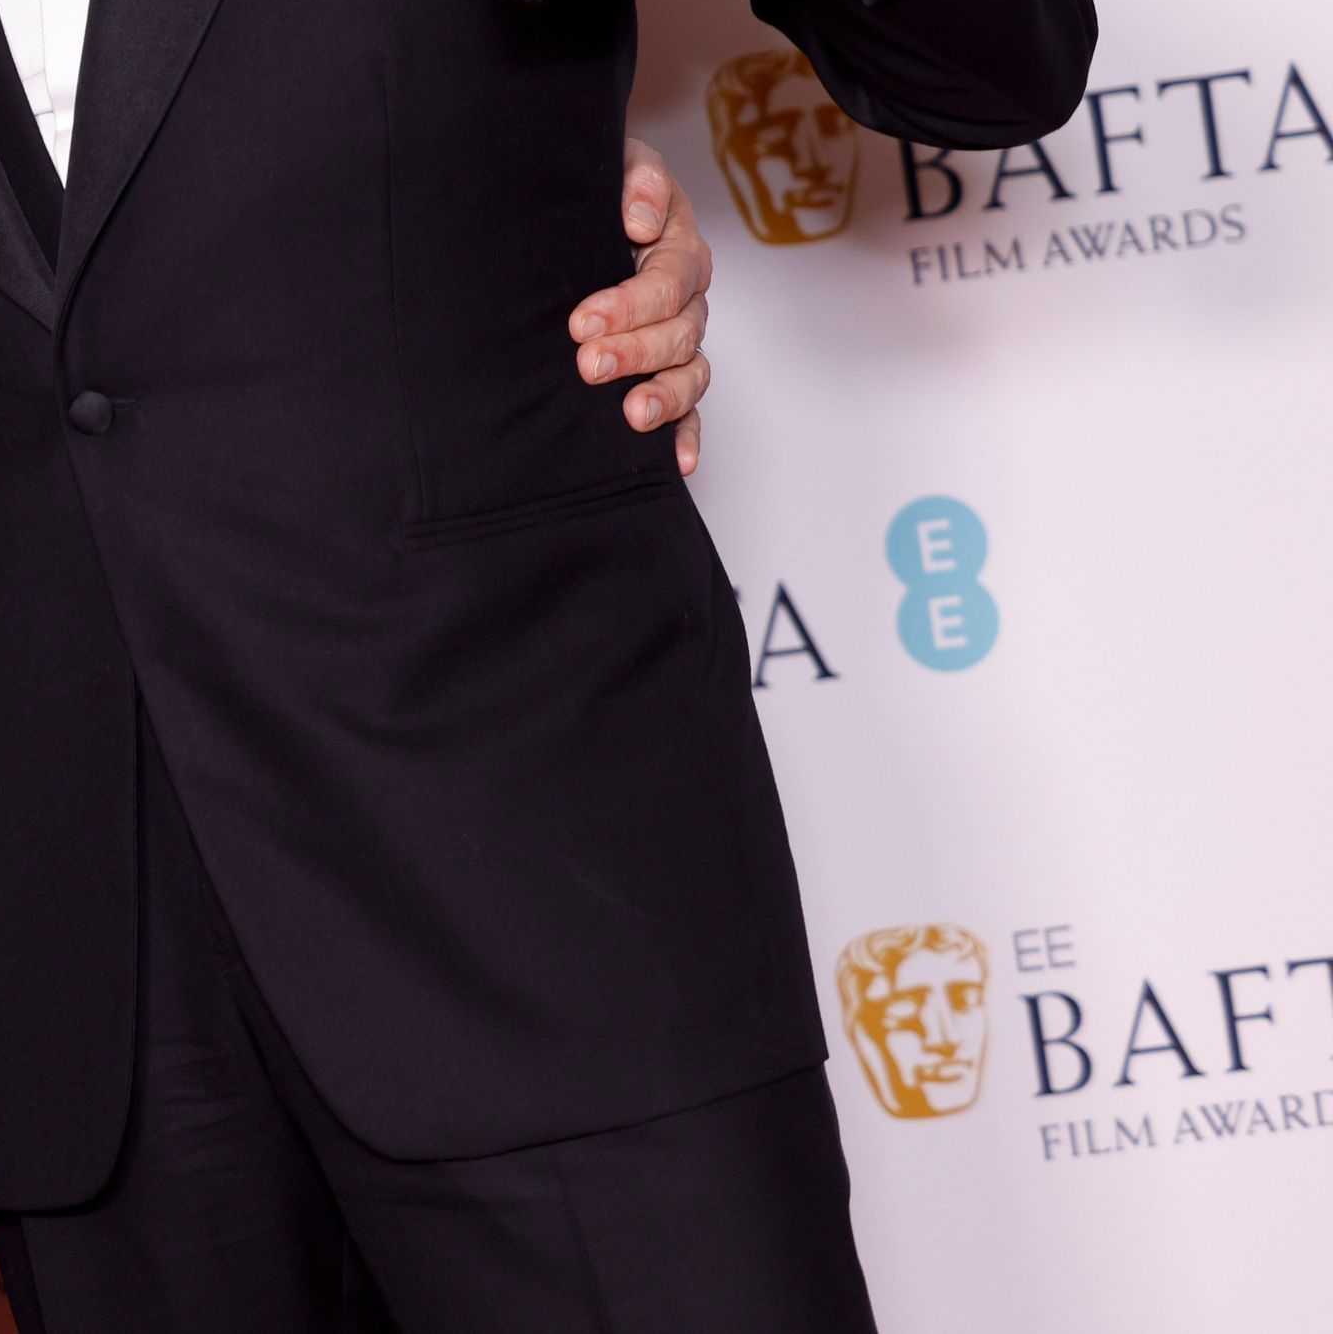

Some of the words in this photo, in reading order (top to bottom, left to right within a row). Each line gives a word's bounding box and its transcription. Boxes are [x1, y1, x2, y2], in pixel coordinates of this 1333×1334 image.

[908, 237, 1026, 287] FILM
[1042, 204, 1247, 270] AWARDS
[1011, 923, 1076, 973] EE
[1038, 1116, 1157, 1160] FILM
[1172, 1090, 1333, 1146] AWARD
